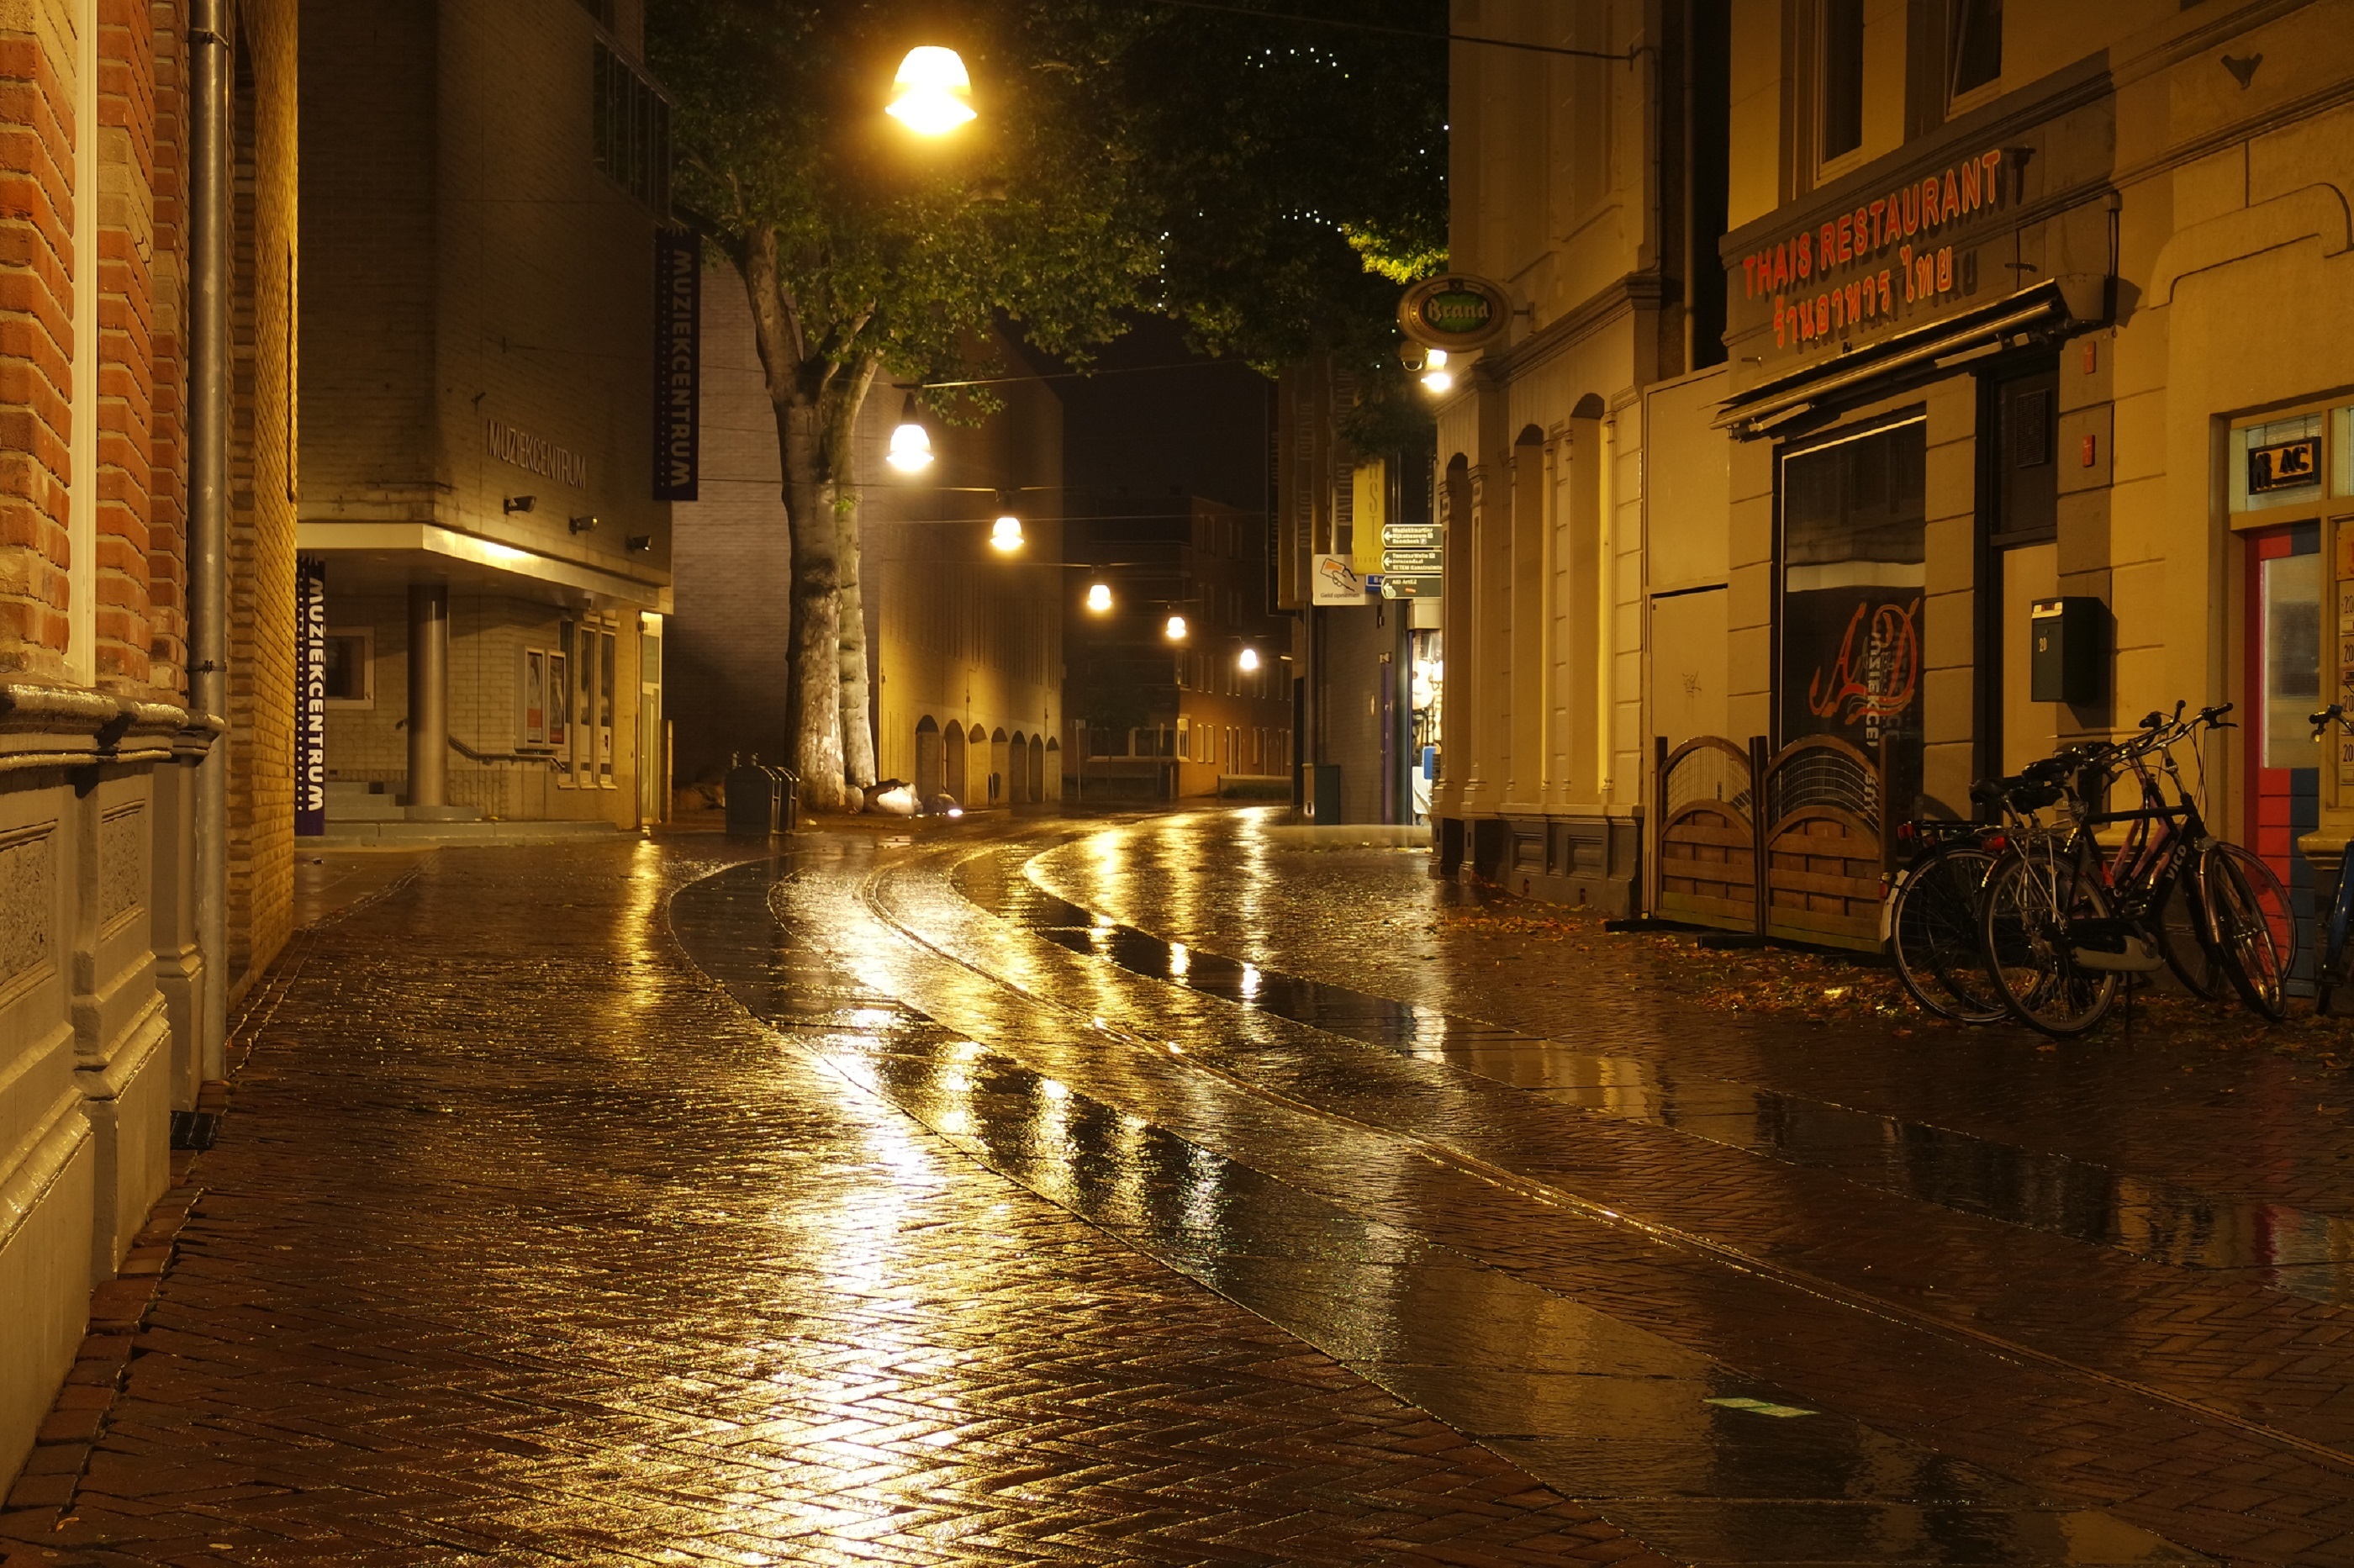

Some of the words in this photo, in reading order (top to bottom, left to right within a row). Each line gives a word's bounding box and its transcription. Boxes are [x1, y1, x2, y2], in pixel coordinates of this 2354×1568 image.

[1743, 232, 1812, 299] THAIS
[1820, 149, 2001, 271] RESTAURANT
[1428, 297, 1490, 322] Brand
[670, 249, 692, 487] MUZIEKCENTRUM
[488, 420, 585, 488] MUZIEKCENTRUM
[2039, 637, 2048, 652] 20
[307, 577, 324, 812] MUZIEKCENTRUM
[2343, 744, 2353, 762] 20
